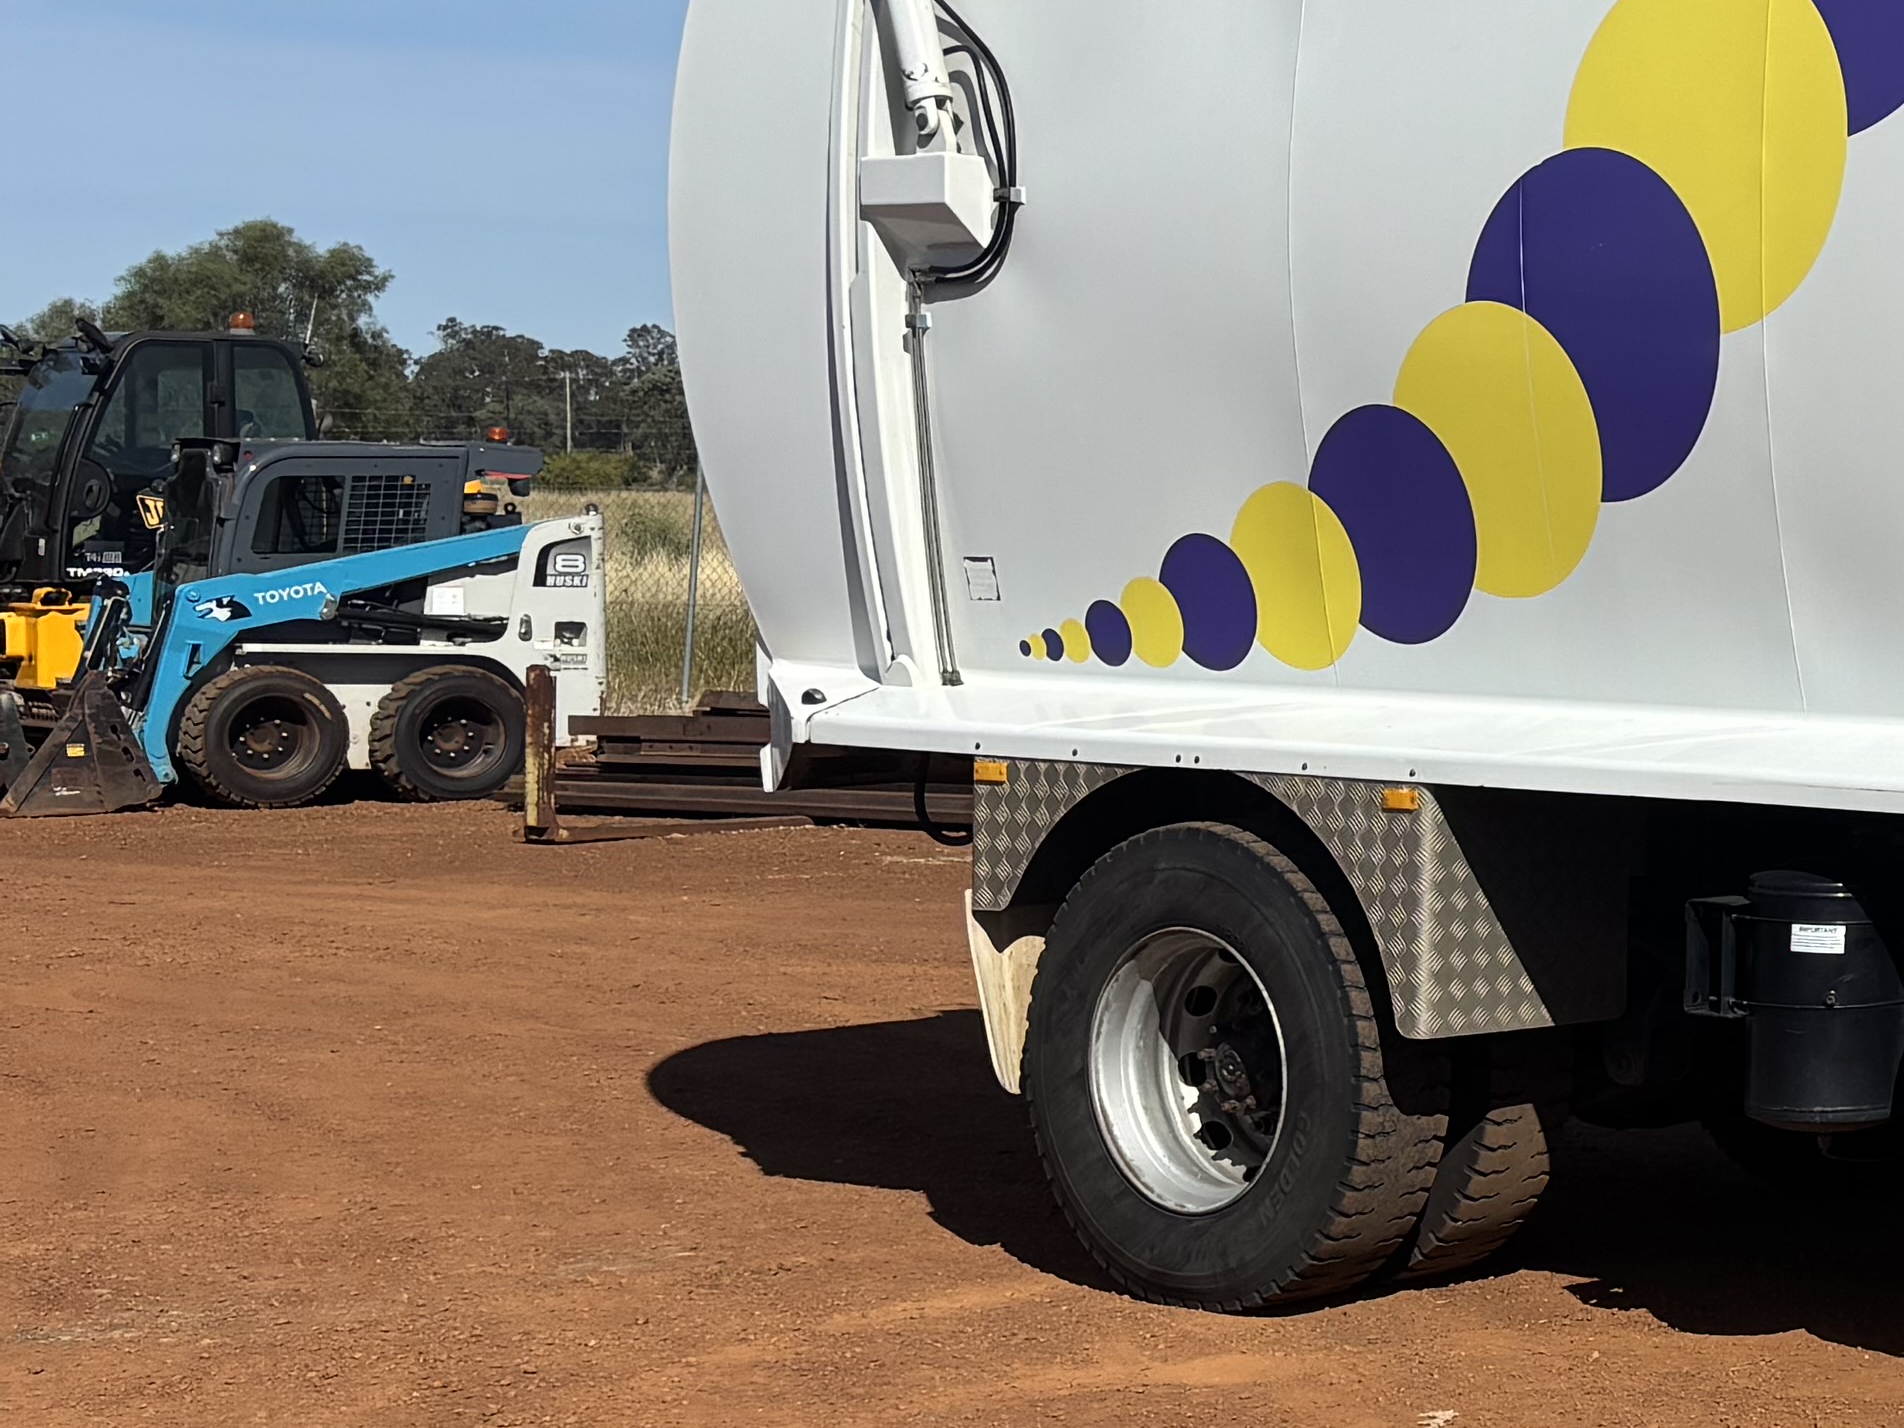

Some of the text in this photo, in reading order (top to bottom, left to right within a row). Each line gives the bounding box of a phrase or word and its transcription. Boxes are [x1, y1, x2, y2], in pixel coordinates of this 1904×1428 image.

[554, 553, 586, 574] 8
[546, 575, 587, 587] HUSKI
[253, 581, 328, 606] TOYOTA
